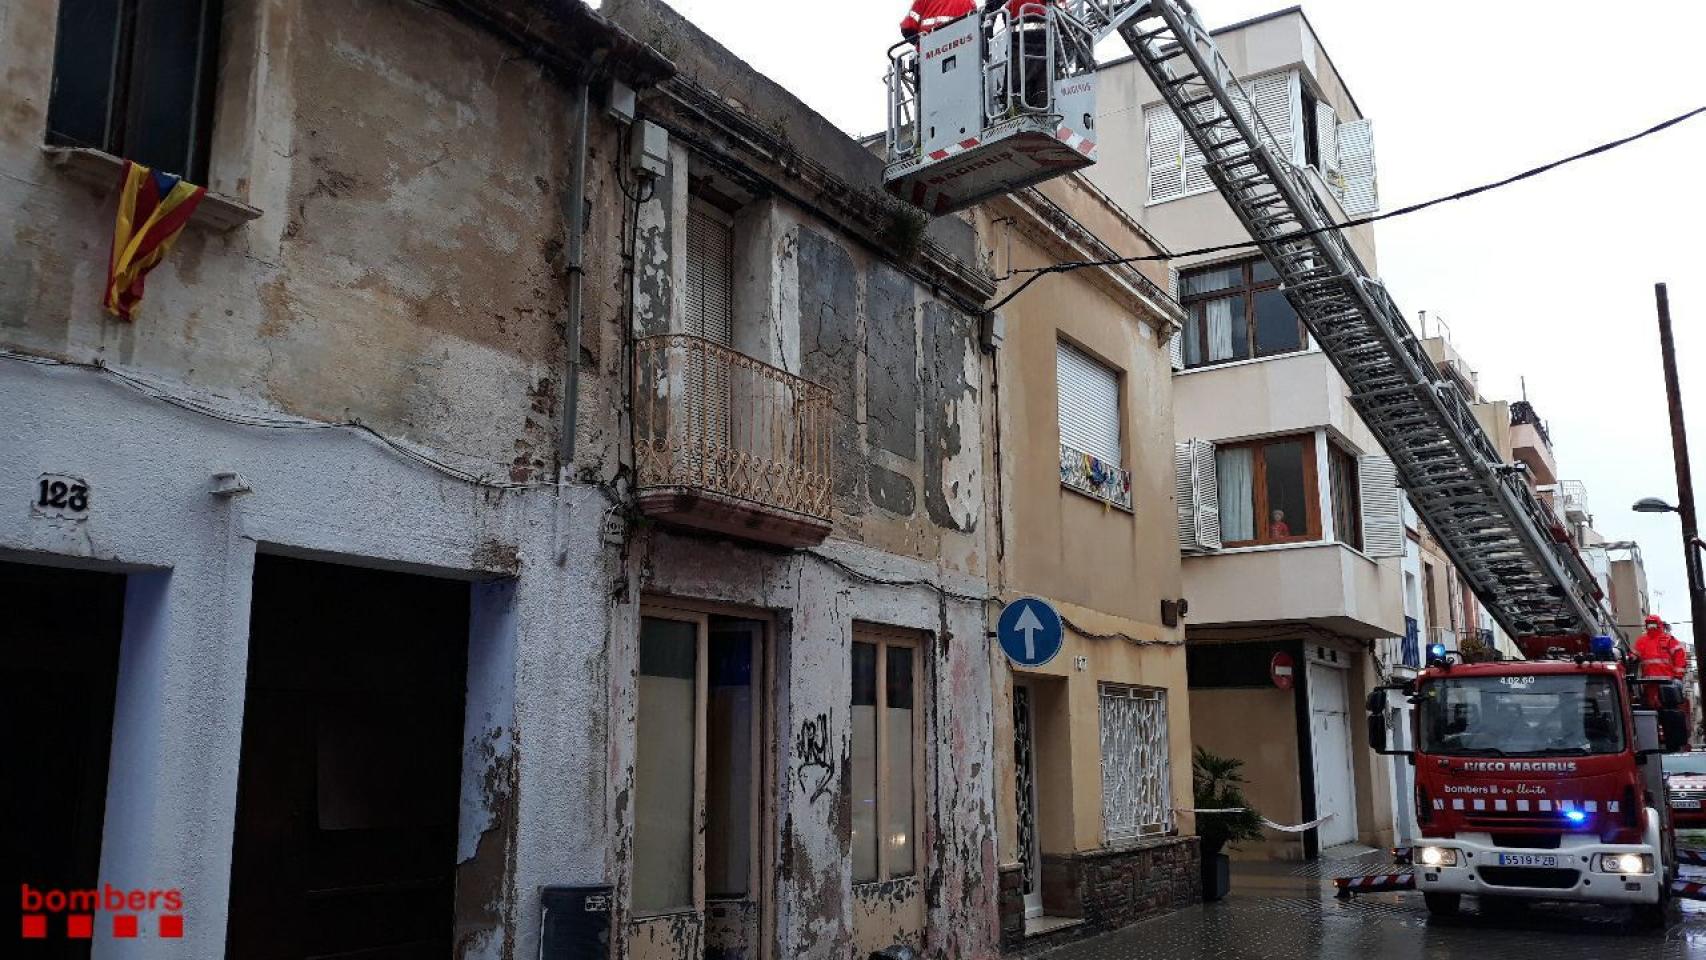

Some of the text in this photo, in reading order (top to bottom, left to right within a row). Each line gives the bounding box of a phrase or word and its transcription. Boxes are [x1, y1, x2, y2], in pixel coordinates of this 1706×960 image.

[926, 33, 973, 60] MAGIRUS
[38, 479, 88, 513] 123
[1464, 762, 1577, 772] IVECO MAGIRUS
[1444, 784, 1489, 793] bombers
[1505, 855, 1532, 865] 5519
